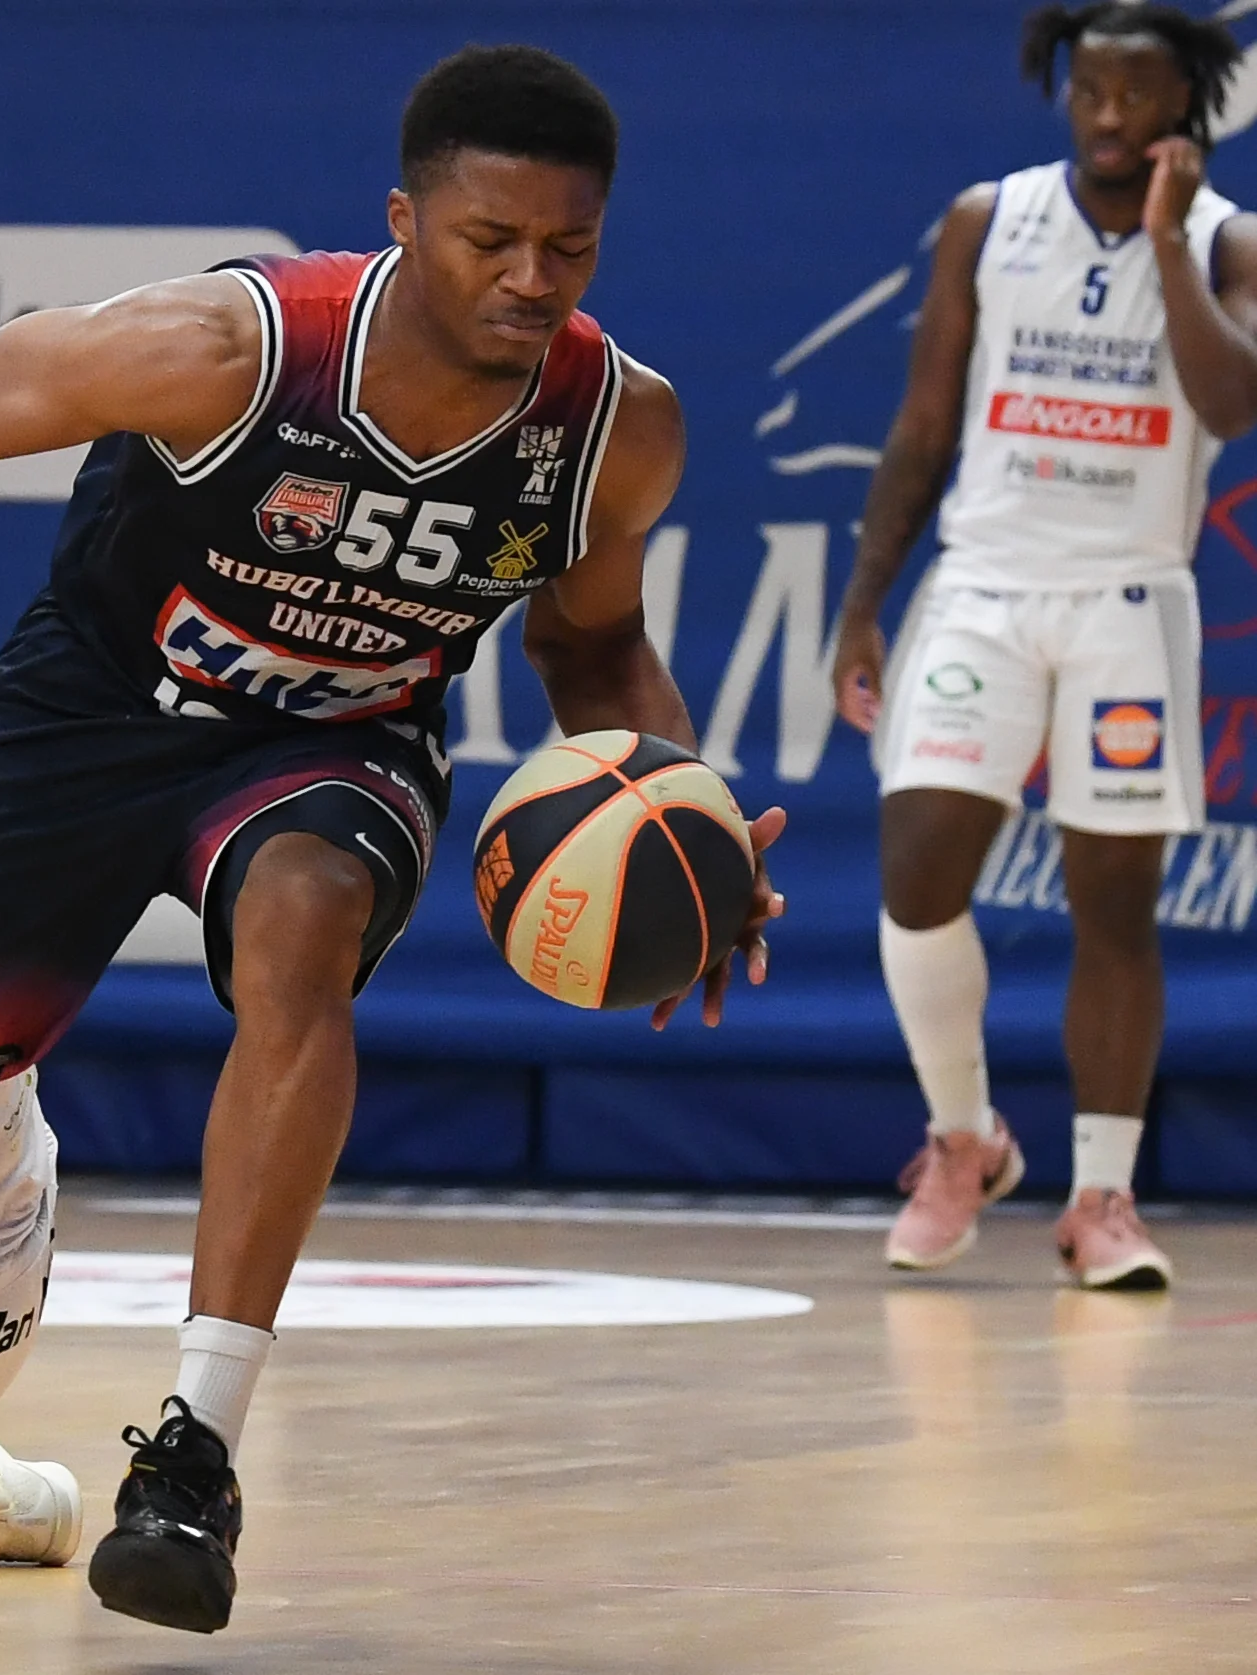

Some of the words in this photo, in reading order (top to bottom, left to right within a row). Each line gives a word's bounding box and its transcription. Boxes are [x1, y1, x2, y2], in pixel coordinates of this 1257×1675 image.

[1081, 263, 1108, 316] 5
[277, 422, 341, 452] CRAFT
[334, 489, 476, 589] 55
[205, 547, 324, 600] HUBO
